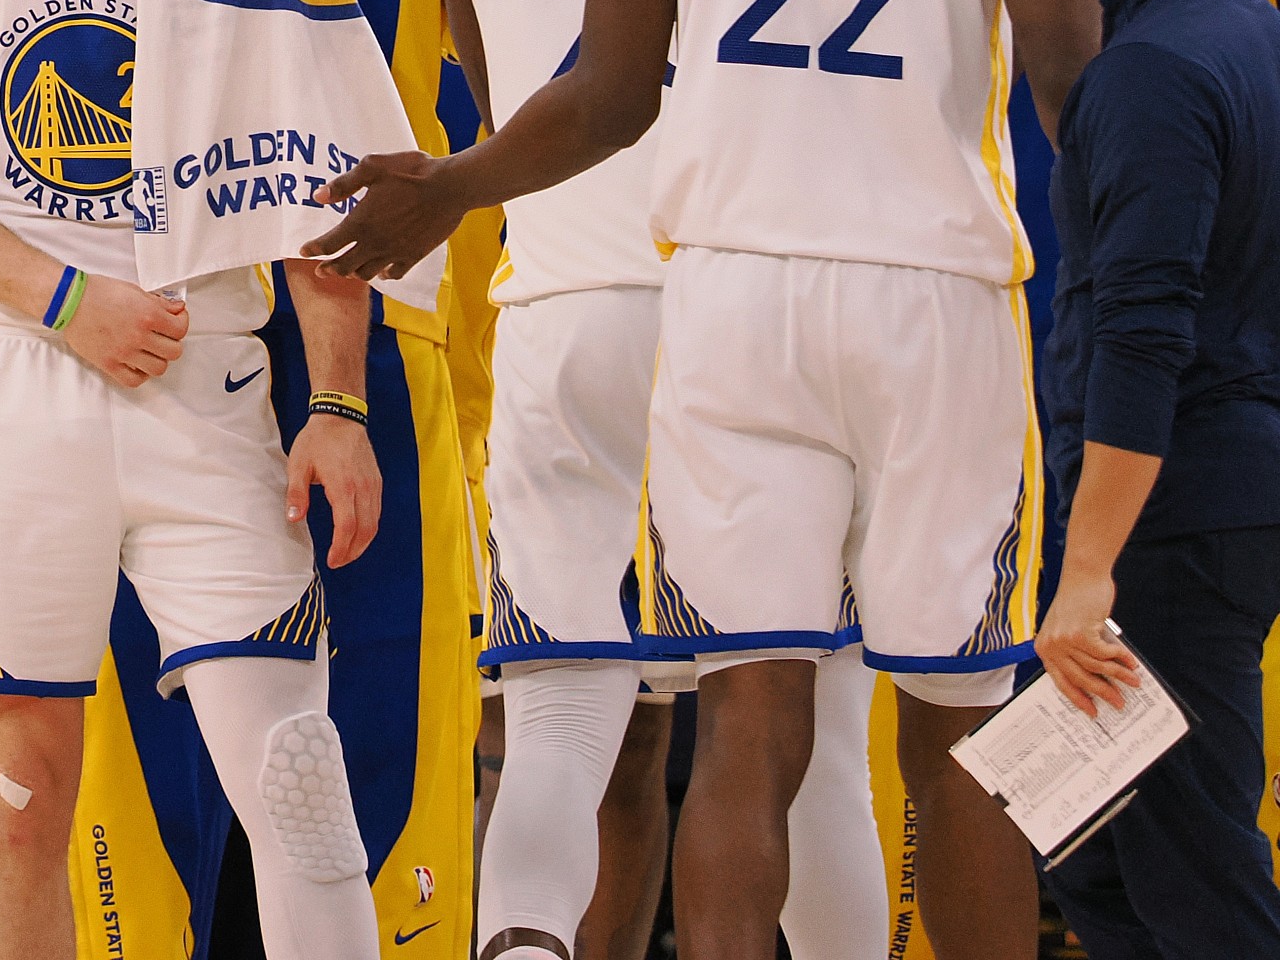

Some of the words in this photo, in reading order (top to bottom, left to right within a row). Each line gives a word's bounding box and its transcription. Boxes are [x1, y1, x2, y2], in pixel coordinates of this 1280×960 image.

[173, 129, 317, 190] GOLDEN
[315, 404, 340, 413] NAME
[92, 824, 116, 907] GOLDEN
